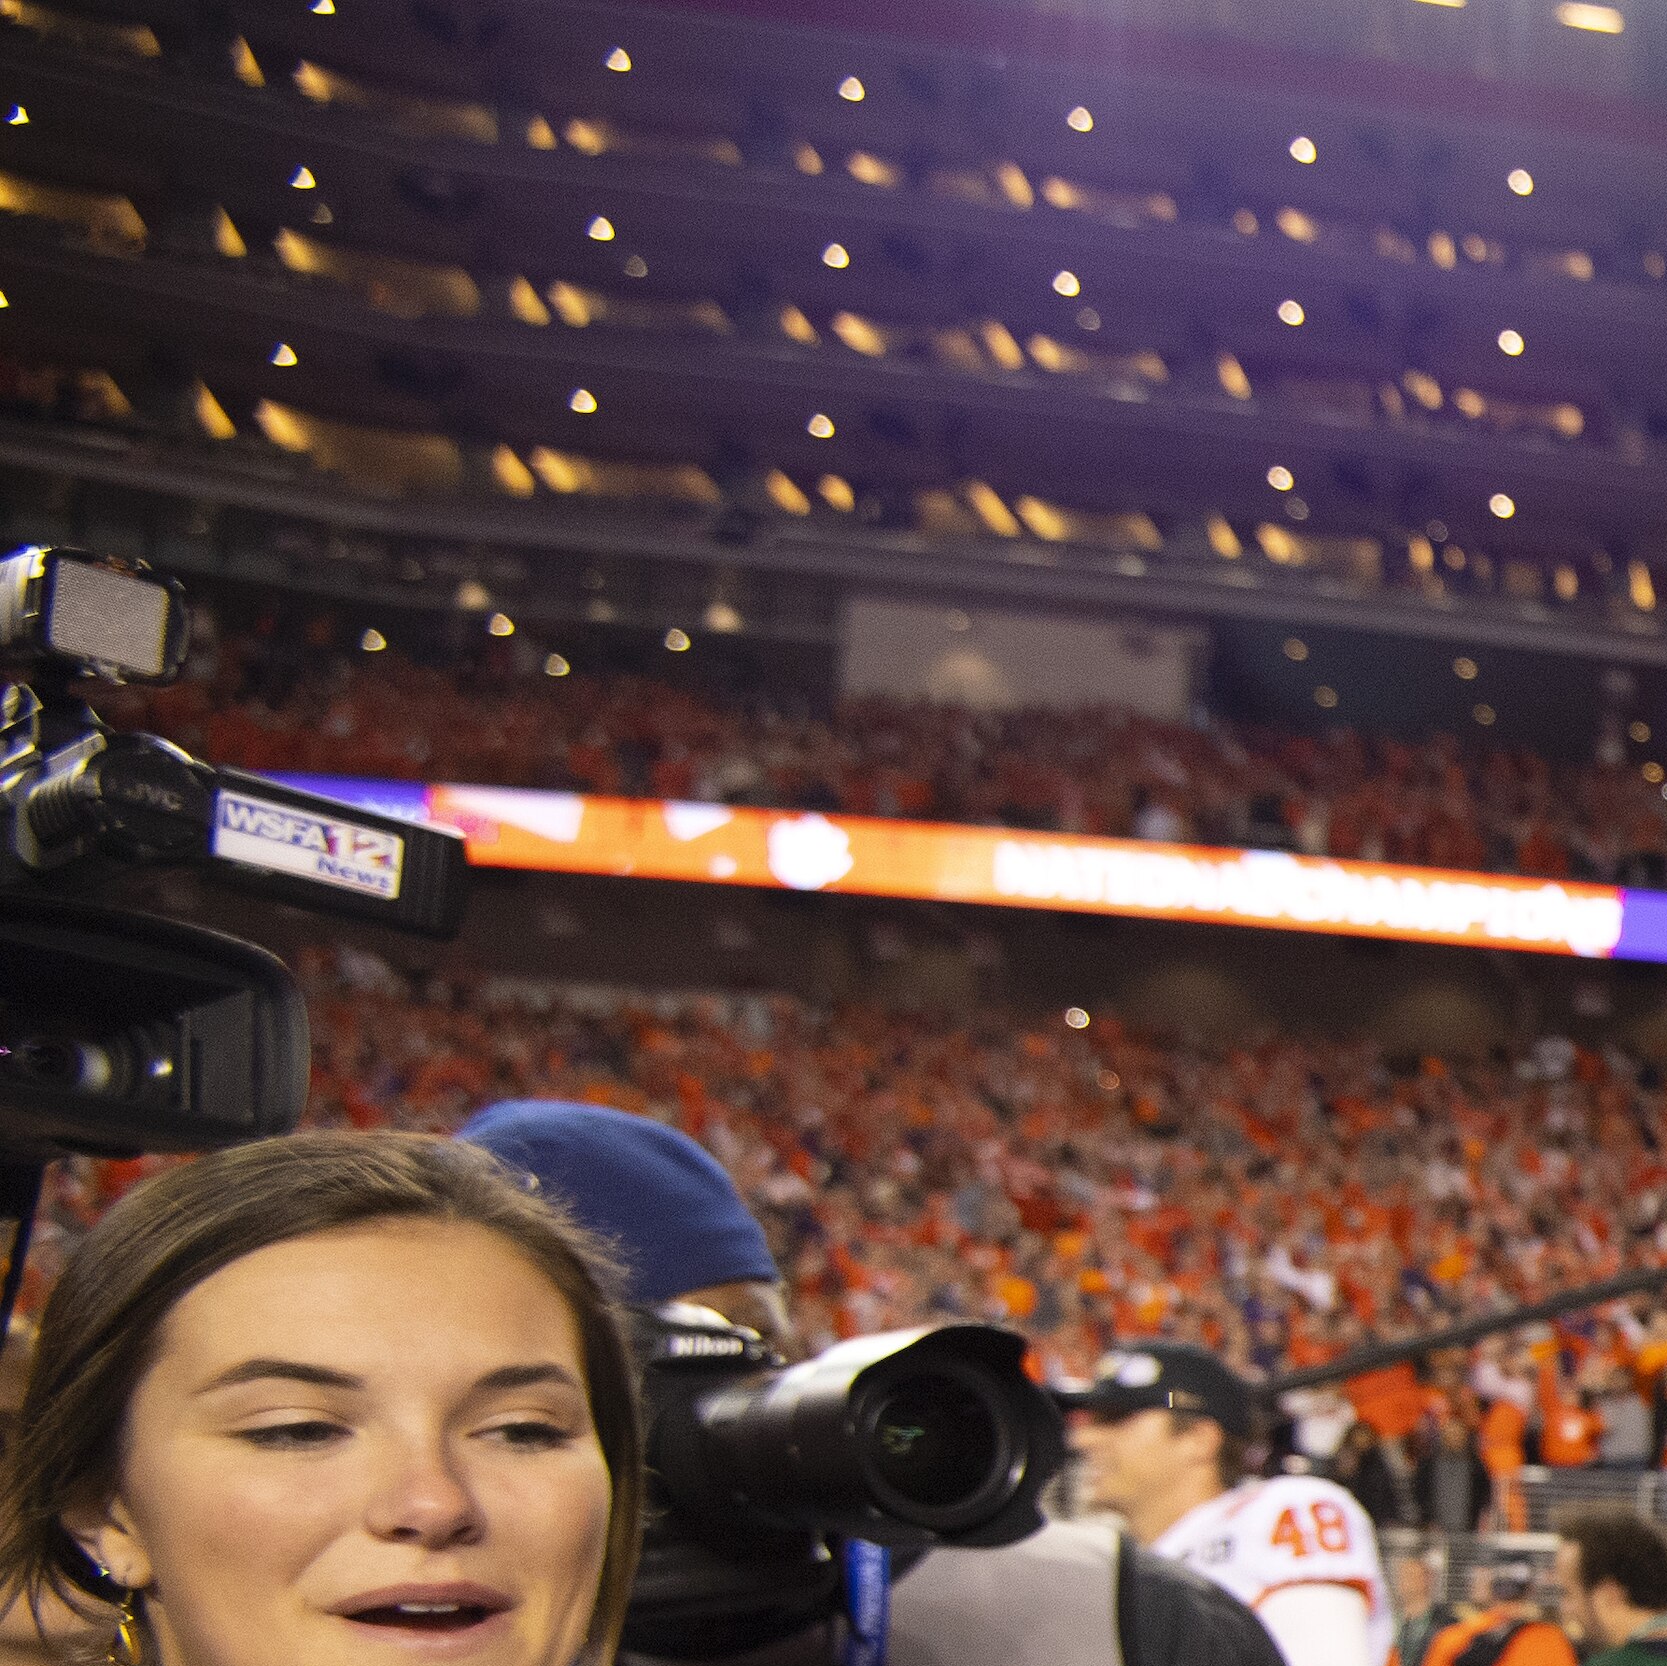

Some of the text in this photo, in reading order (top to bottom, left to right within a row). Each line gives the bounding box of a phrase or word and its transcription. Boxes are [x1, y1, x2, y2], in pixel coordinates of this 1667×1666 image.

[222, 800, 328, 853] WSFA
[327, 823, 397, 868] 12
[317, 855, 391, 889] News
[670, 1334, 744, 1356] Nikon
[1269, 1500, 1351, 1558] 48
